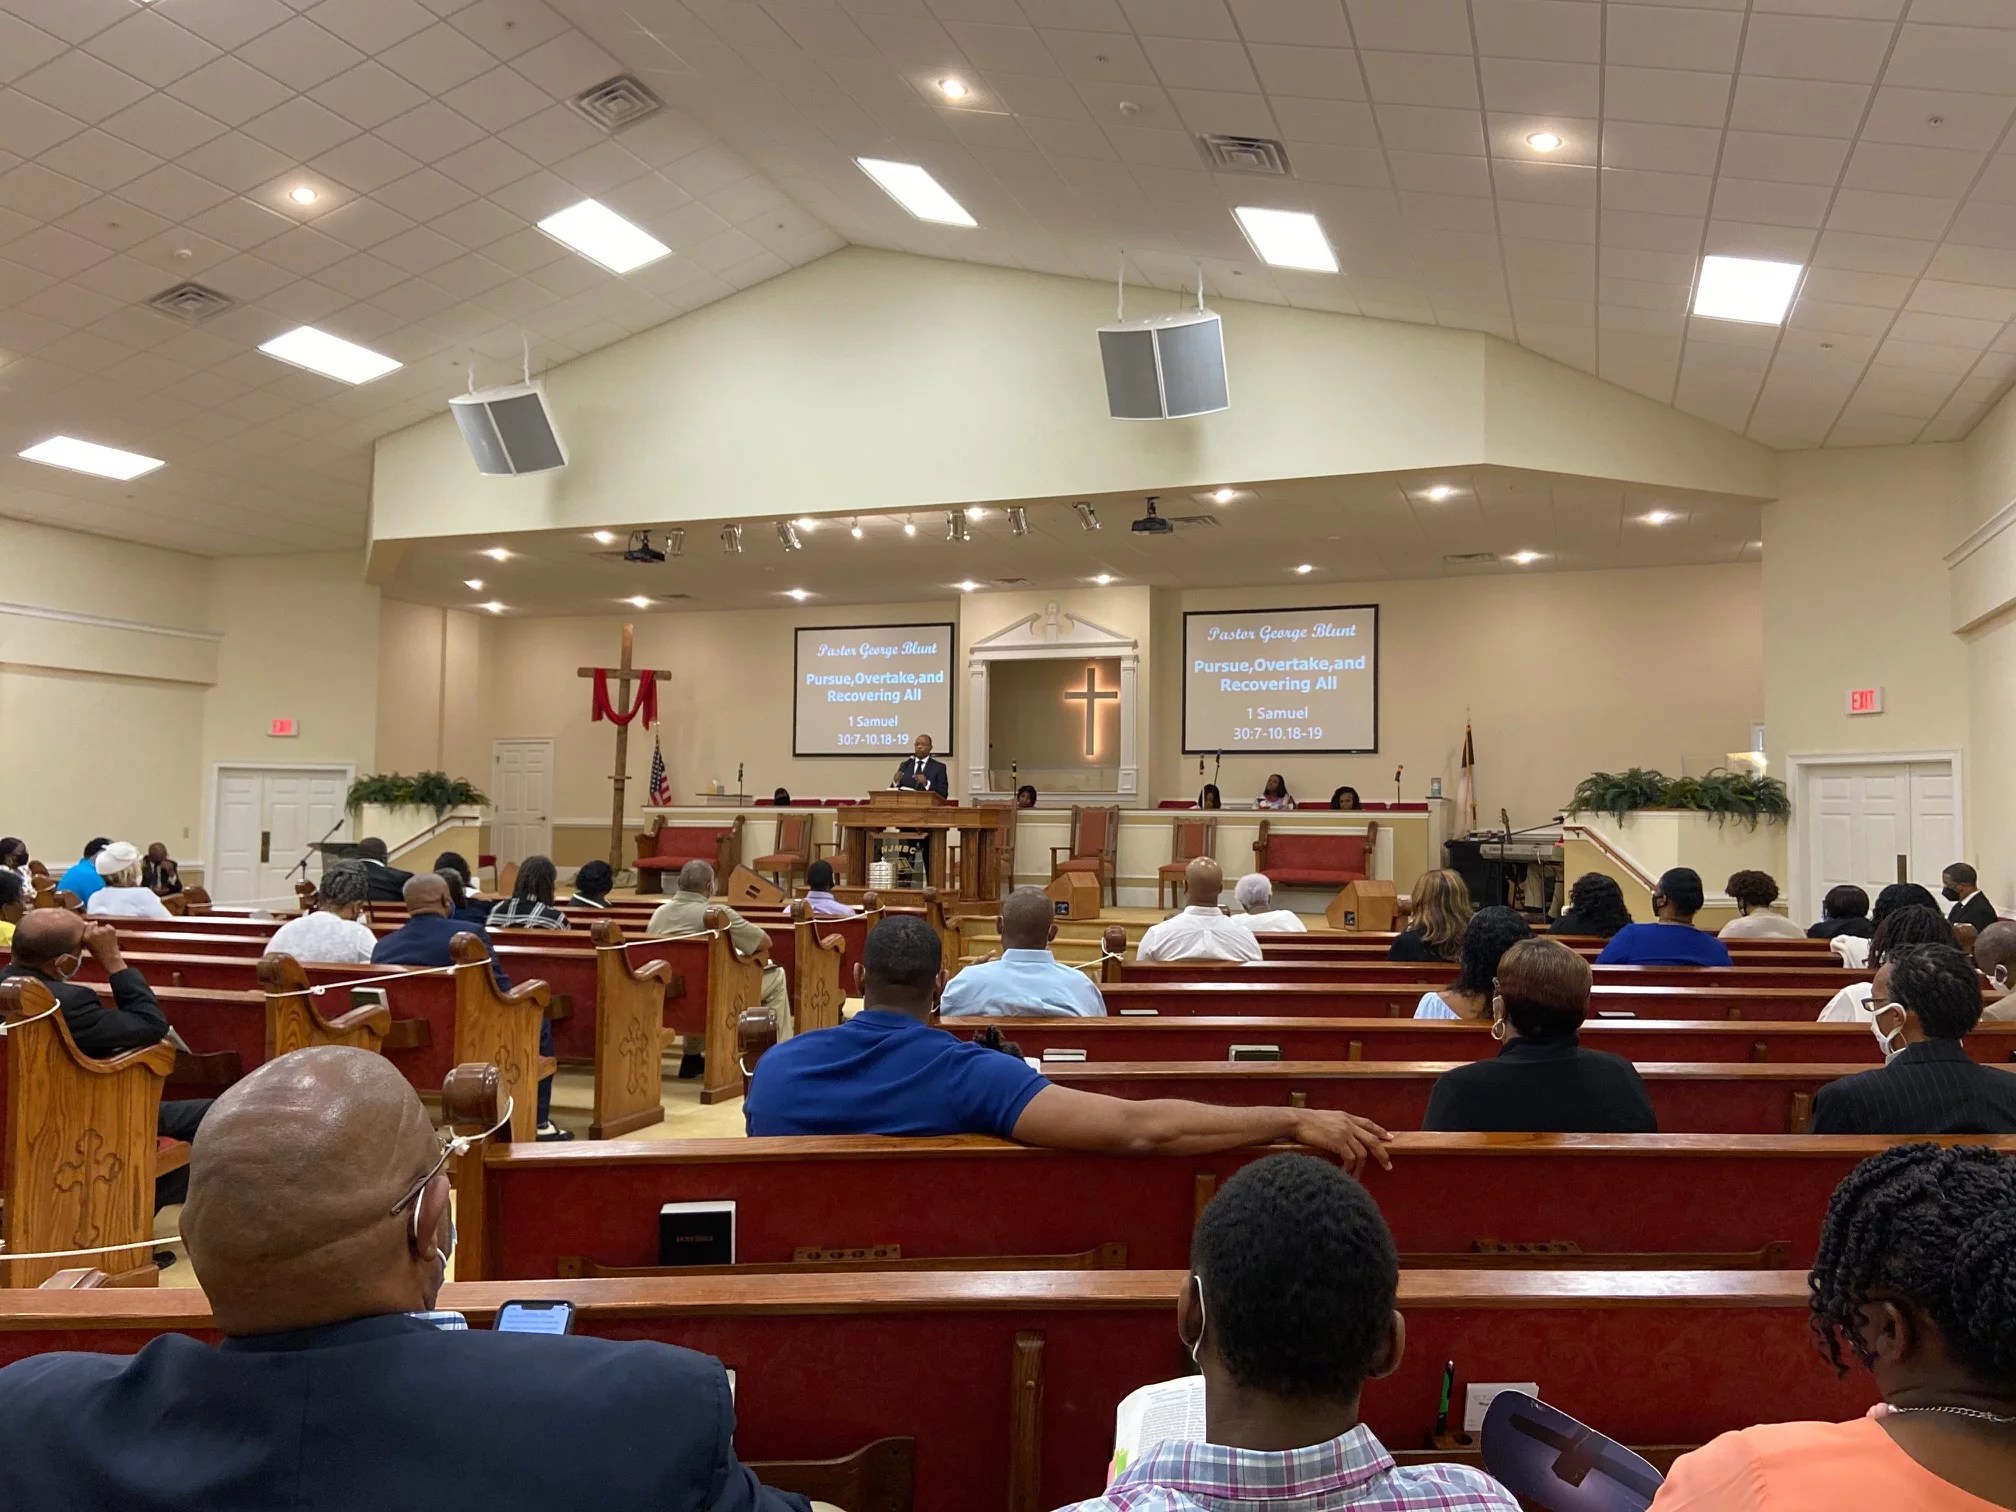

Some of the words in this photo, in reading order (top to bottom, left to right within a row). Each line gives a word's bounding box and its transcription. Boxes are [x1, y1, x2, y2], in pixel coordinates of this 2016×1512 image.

[1207, 626, 1255, 640] Pastor
[1259, 625, 1308, 643] George
[1311, 623, 1357, 638] Blunt
[817, 643, 857, 657] Pastor
[859, 642, 898, 659] George
[901, 641, 937, 655] Blunt
[1220, 677, 1311, 693] Recovering
[1315, 675, 1337, 690] All
[827, 688, 900, 704] Recovering
[904, 688, 921, 701] All
[1852, 690, 1874, 710] EXIT
[1246, 707, 1252, 720] 1
[1257, 706, 1309, 720] Samuel
[848, 716, 853, 727] 1
[857, 715, 898, 728] Samuel
[837, 733, 909, 745] 30:7-10.18-19
[1233, 726, 1323, 740] 30:7-10.18-19
[881, 844, 917, 854] NJMBC
